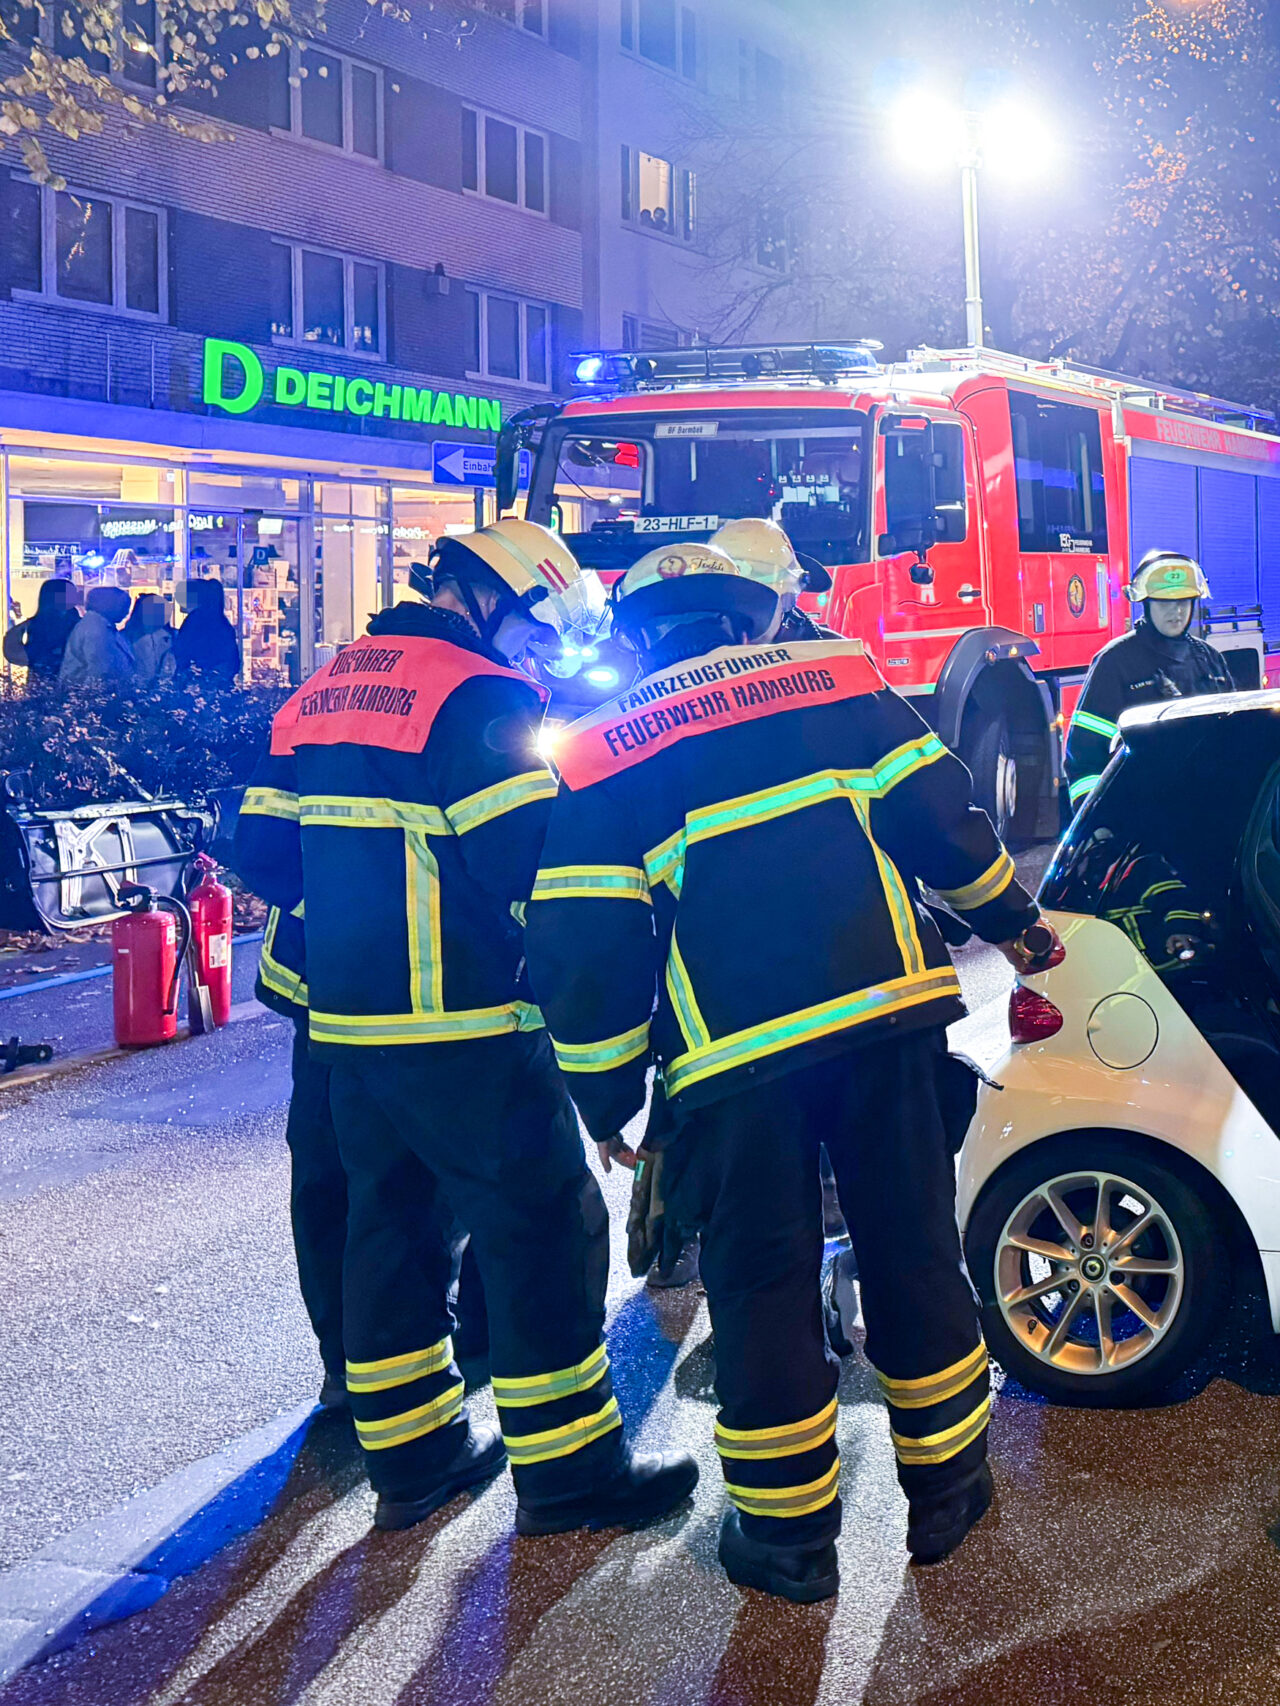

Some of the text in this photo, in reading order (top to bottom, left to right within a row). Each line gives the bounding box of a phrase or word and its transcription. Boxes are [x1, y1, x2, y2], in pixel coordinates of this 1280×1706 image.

[204, 337, 264, 414] D
[275, 366, 501, 432] DEICHMANN
[667, 425, 703, 434] BF Barmbek
[1156, 417, 1222, 452] FEUERWEHR
[643, 517, 709, 531] 23-HLF-1
[347, 684, 417, 717] HAMBURG
[603, 669, 836, 757] FEUERWEHR HAMBURG
